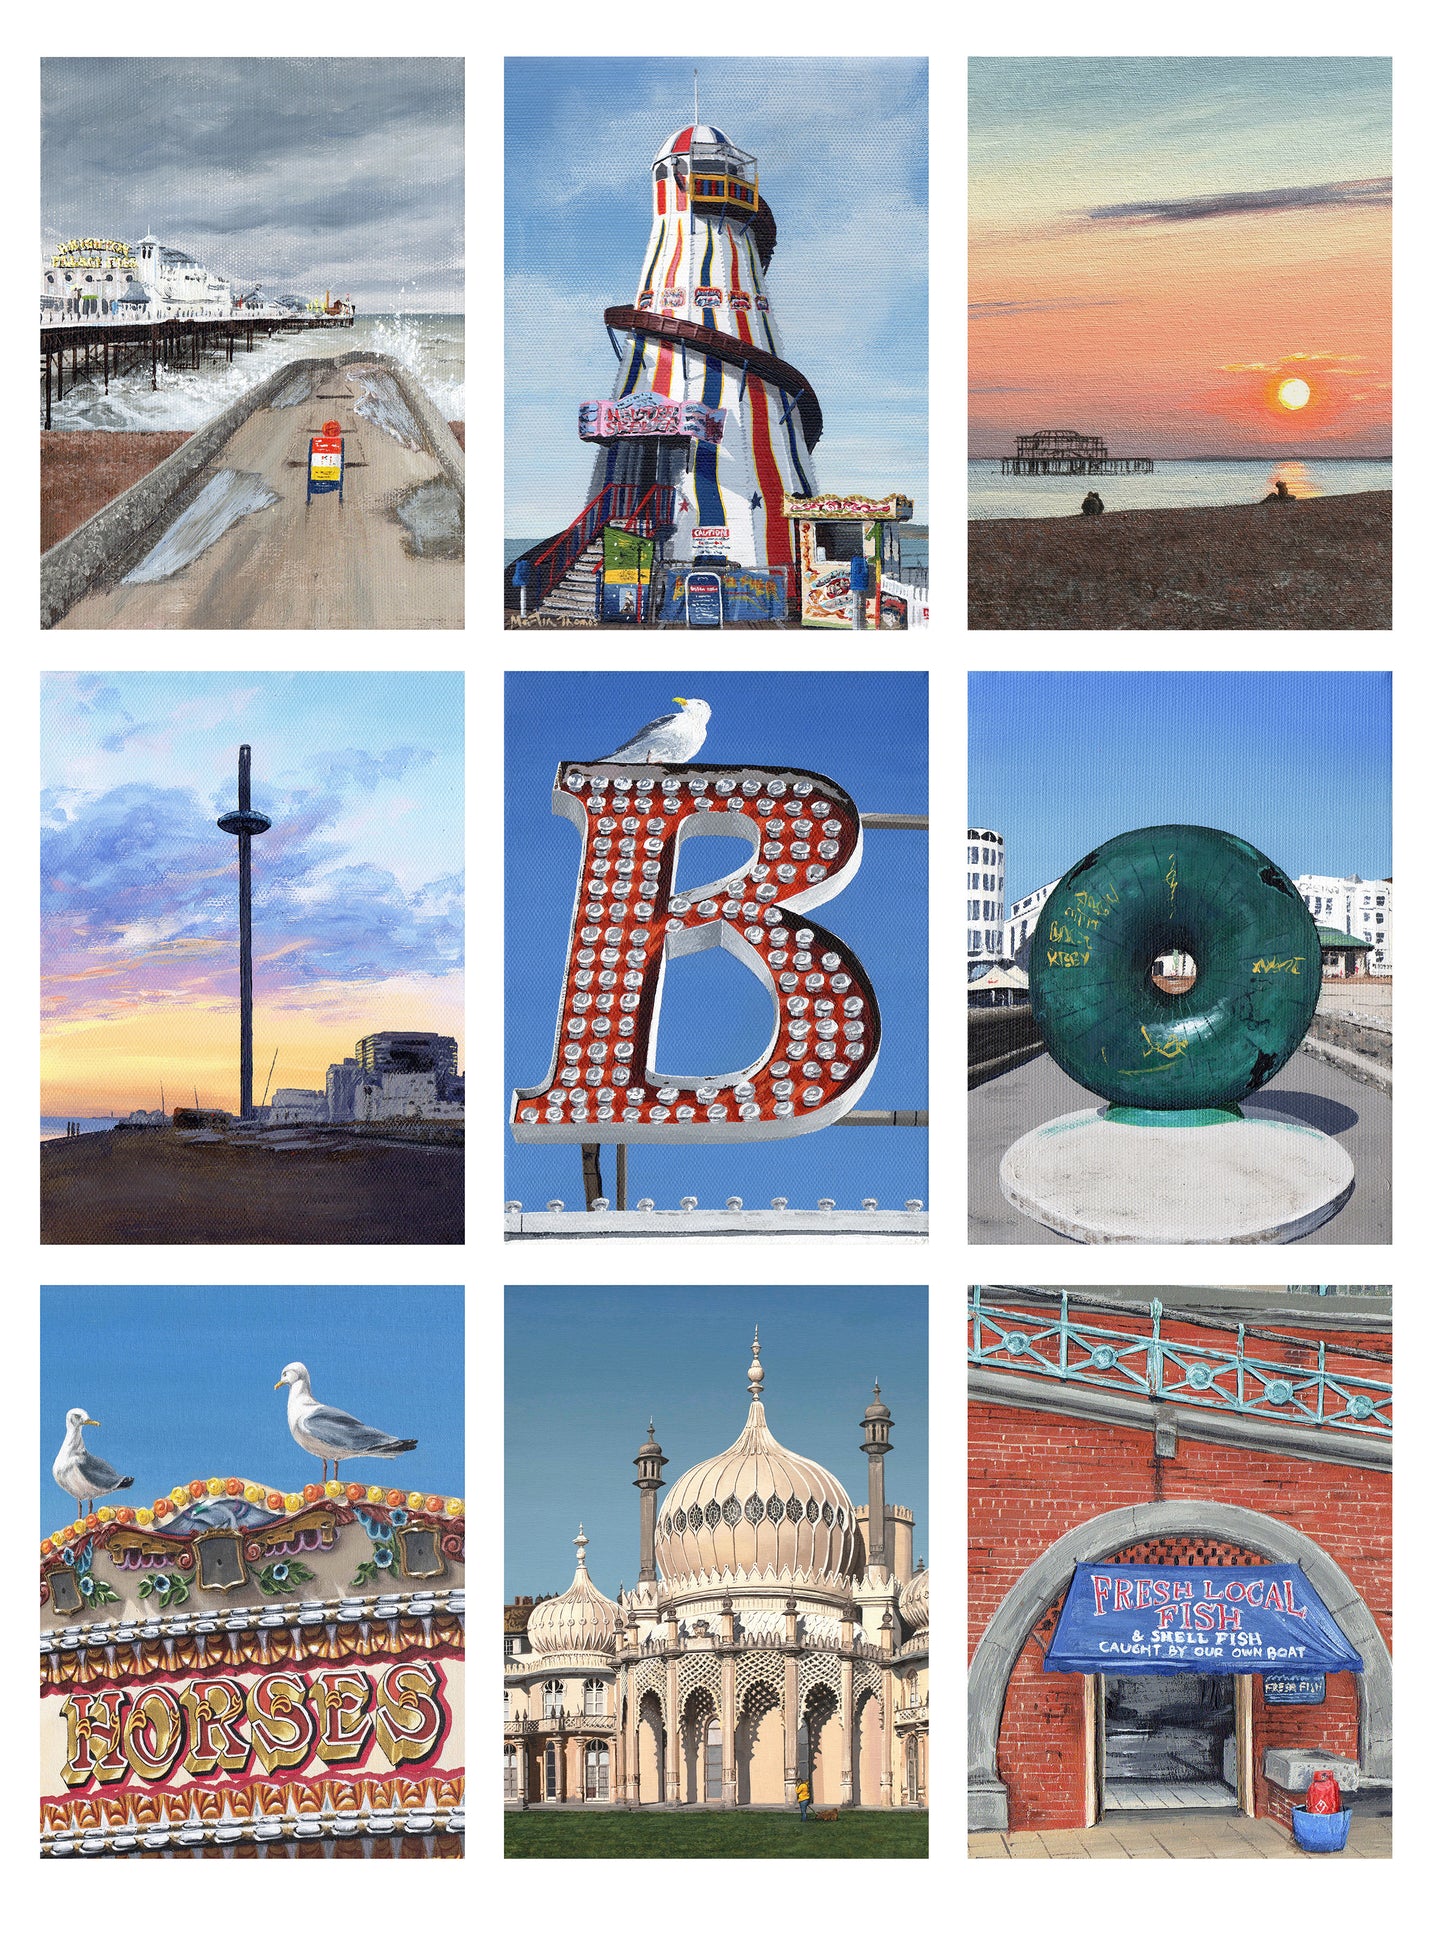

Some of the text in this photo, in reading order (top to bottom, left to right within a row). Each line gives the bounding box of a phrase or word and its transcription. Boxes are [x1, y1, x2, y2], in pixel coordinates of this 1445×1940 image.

[693, 529, 728, 537] CAUTION
[509, 761, 883, 1145] B
[1091, 1575, 1308, 1619] FRESH LOCAL
[1154, 1602, 1243, 1632] FISH
[1099, 1641, 1306, 1661] CAUGHT BY OUR OWN BOAT
[1131, 1629, 1263, 1647] & SHELL FISH
[60, 1662, 445, 1788] HORSES
